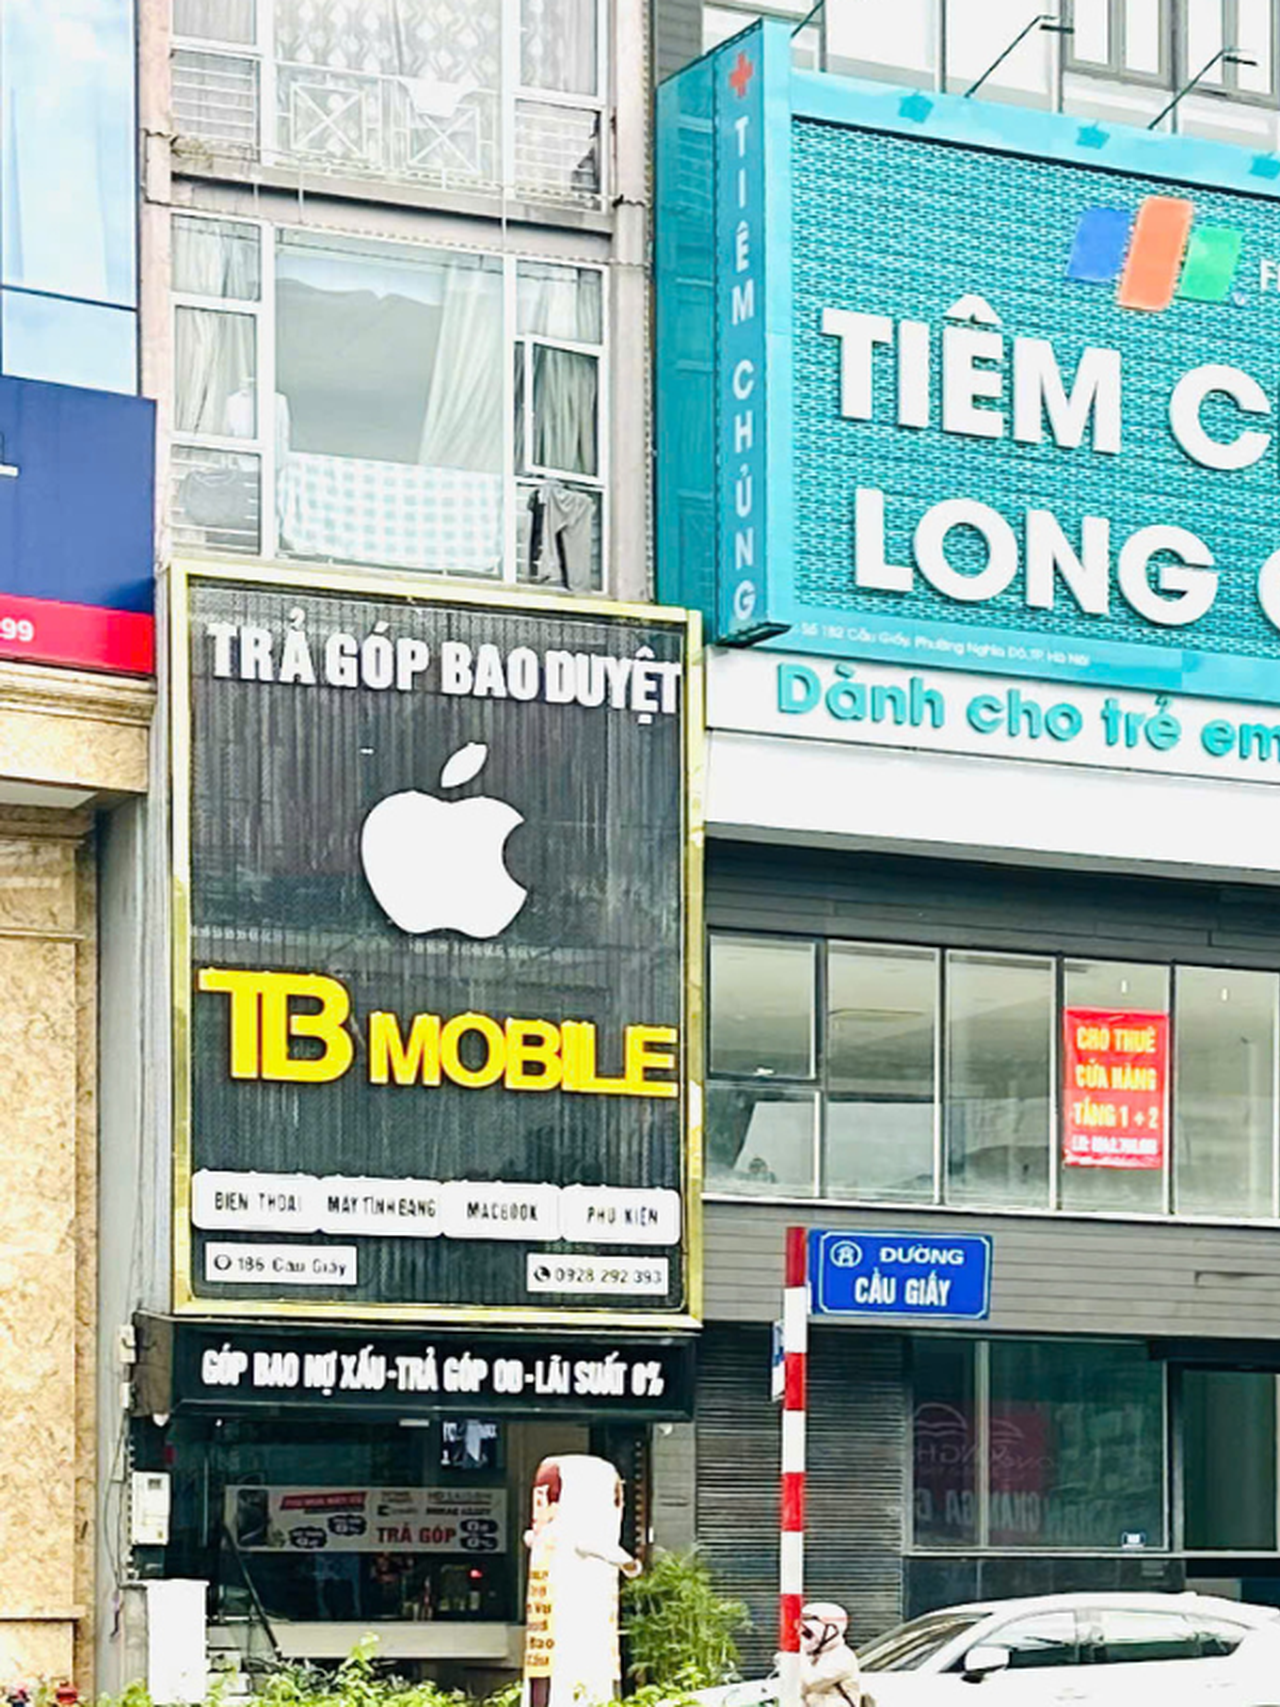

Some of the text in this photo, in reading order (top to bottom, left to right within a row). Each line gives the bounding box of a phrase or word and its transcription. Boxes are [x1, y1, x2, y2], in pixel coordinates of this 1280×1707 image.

[731, 115, 757, 621] TIÊM CHỦNG
[820, 293, 1123, 455] TIÊM
[855, 488, 1219, 626] LONG
[207, 607, 683, 725] TRẢ GÓP BAO DUYỆT
[776, 661, 945, 729] Dành
[966, 688, 1084, 742] cho
[1102, 694, 1183, 752] trẻ
[198, 966, 680, 1098] TB MOBILE
[1076, 1025, 1157, 1053] CHO THUÊ
[1119, 1105, 1129, 1128] 1
[1148, 1105, 1159, 1129] 2
[466, 1201, 539, 1222] MACBOOK
[555, 1267, 595, 1283] 0928
[599, 1268, 629, 1284] 292
[879, 1243, 966, 1266] ĐƯỜNG
[854, 1267, 952, 1306] CẦU GIẤY
[202, 1343, 249, 1386] GÓP
[253, 1352, 300, 1387] BAO
[303, 1350, 338, 1397] NỢ
[443, 1351, 489, 1392] GÓP
[573, 1350, 628, 1396] SUẤT
[631, 1360, 665, 1397] 0%
[376, 1522, 457, 1544] TRẢ GÓP
